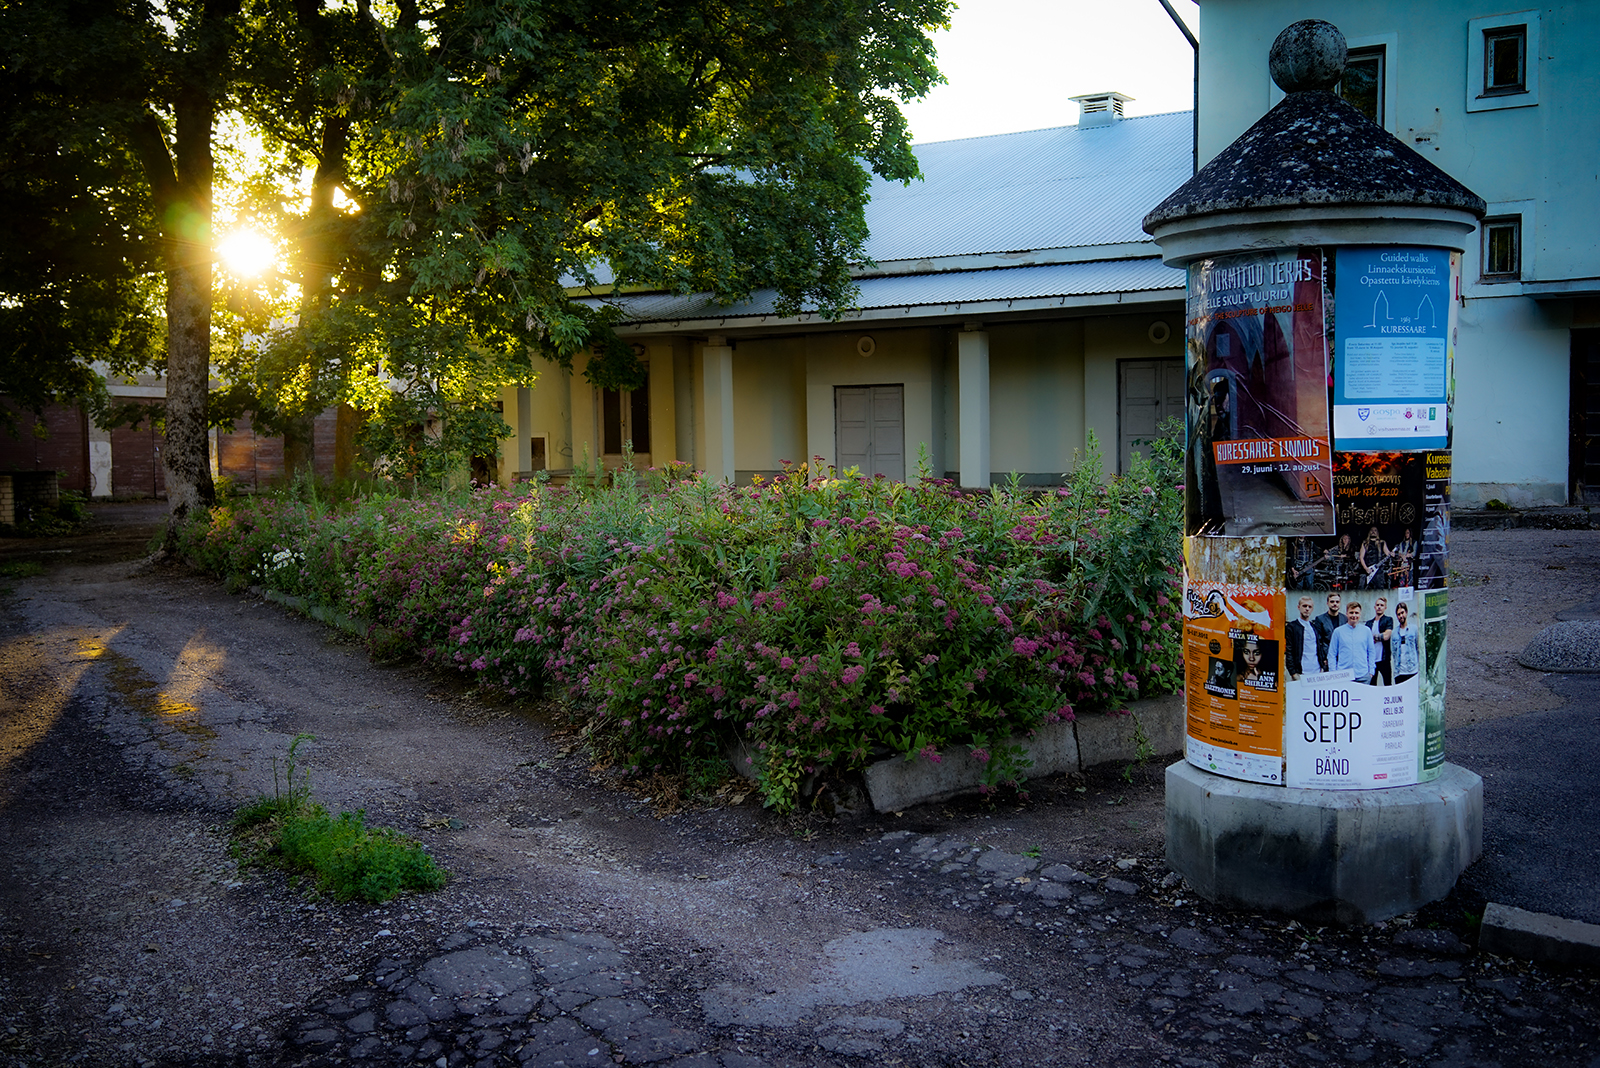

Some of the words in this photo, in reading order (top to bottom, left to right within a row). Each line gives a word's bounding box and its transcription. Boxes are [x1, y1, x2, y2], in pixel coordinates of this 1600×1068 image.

[1380, 252, 1409, 262] Guided
[1410, 253, 1429, 262] walks
[1269, 259, 1312, 285] TERAS
[1368, 264, 1437, 275] Linnaekskursioonid
[1360, 275, 1400, 287] Opastettu
[1222, 289, 1289, 307] SKULPTUURID
[1225, 308, 1258, 319] SCULPTURE
[1269, 305, 1292, 313] HEIGO
[1293, 303, 1314, 312] JELLE
[1381, 325, 1427, 334] KURESSAARE
[1217, 441, 1276, 461] KURESSAARE
[1280, 439, 1320, 458] LINNUS
[1241, 465, 1253, 474] 29.
[1253, 464, 1273, 475] juuni
[1279, 464, 1291, 472] 12.
[1293, 464, 1320, 472] august
[1363, 487, 1379, 497] KELL
[1380, 487, 1399, 497] 22.00
[1265, 520, 1325, 528] www.heigojelle.ee
[1228, 631, 1246, 640] MAYA
[1246, 633, 1259, 641] VIK
[1244, 680, 1274, 688] SHIRLEY
[1313, 689, 1349, 708] UUDO
[1383, 707, 1393, 716] KELL
[1303, 711, 1362, 743] SEPP
[1381, 719, 1404, 728] SAAREMAA
[1328, 746, 1337, 755] JA
[1315, 754, 1350, 775] BÄND
